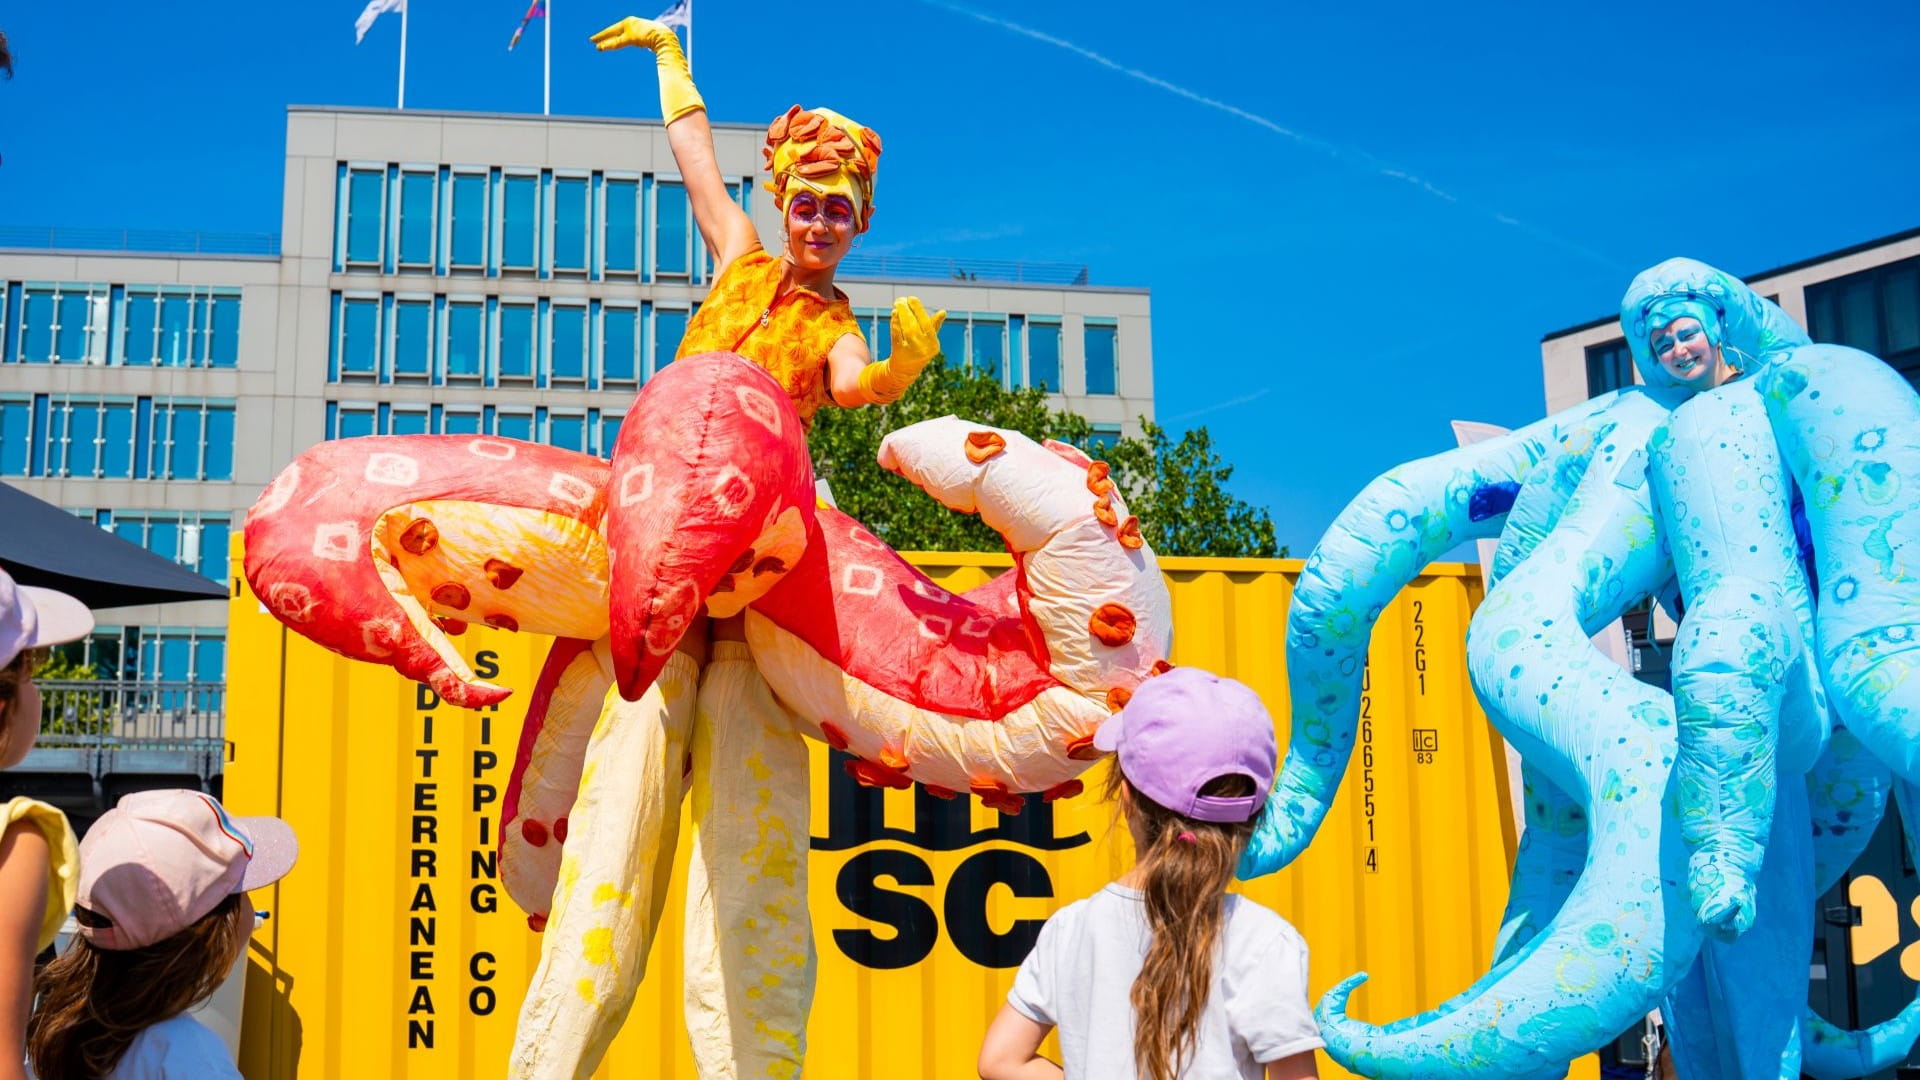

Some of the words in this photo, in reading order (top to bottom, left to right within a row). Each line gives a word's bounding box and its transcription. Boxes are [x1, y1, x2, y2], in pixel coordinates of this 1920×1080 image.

[1414, 601, 1426, 695] 22G1
[470, 650, 499, 914] SIPPING
[1417, 752, 1433, 764] 83
[408, 683, 441, 1049] DITERRANEAN
[469, 951, 497, 1016] CO
